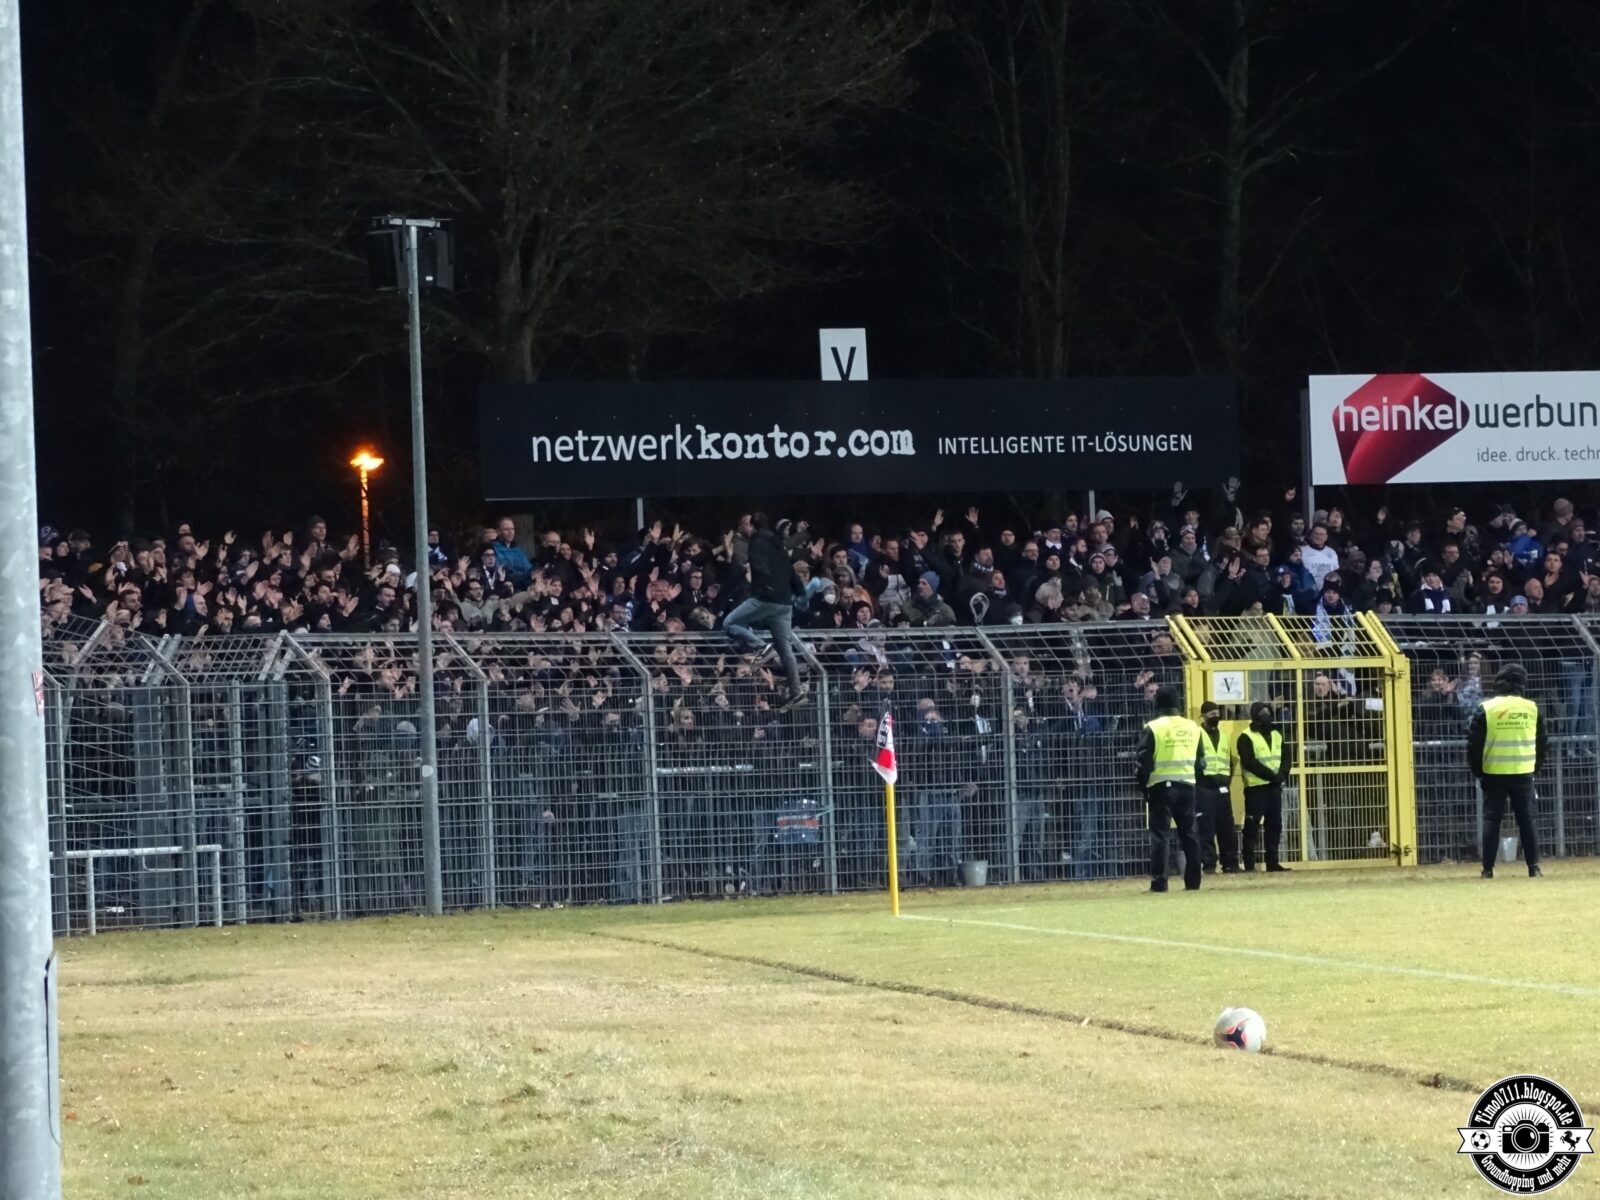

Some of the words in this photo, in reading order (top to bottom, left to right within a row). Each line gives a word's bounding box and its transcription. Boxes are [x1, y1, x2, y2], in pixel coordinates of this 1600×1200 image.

[830, 346, 858, 381] V
[532, 424, 915, 462] netzwerkkontor.com
[938, 436, 1066, 455] INTELLIGENTE
[1071, 431, 1194, 454] IT-LÖSUNGEN
[1476, 446, 1512, 463] idee.
[1515, 445, 1560, 461] druck.
[1223, 677, 1235, 693] V
